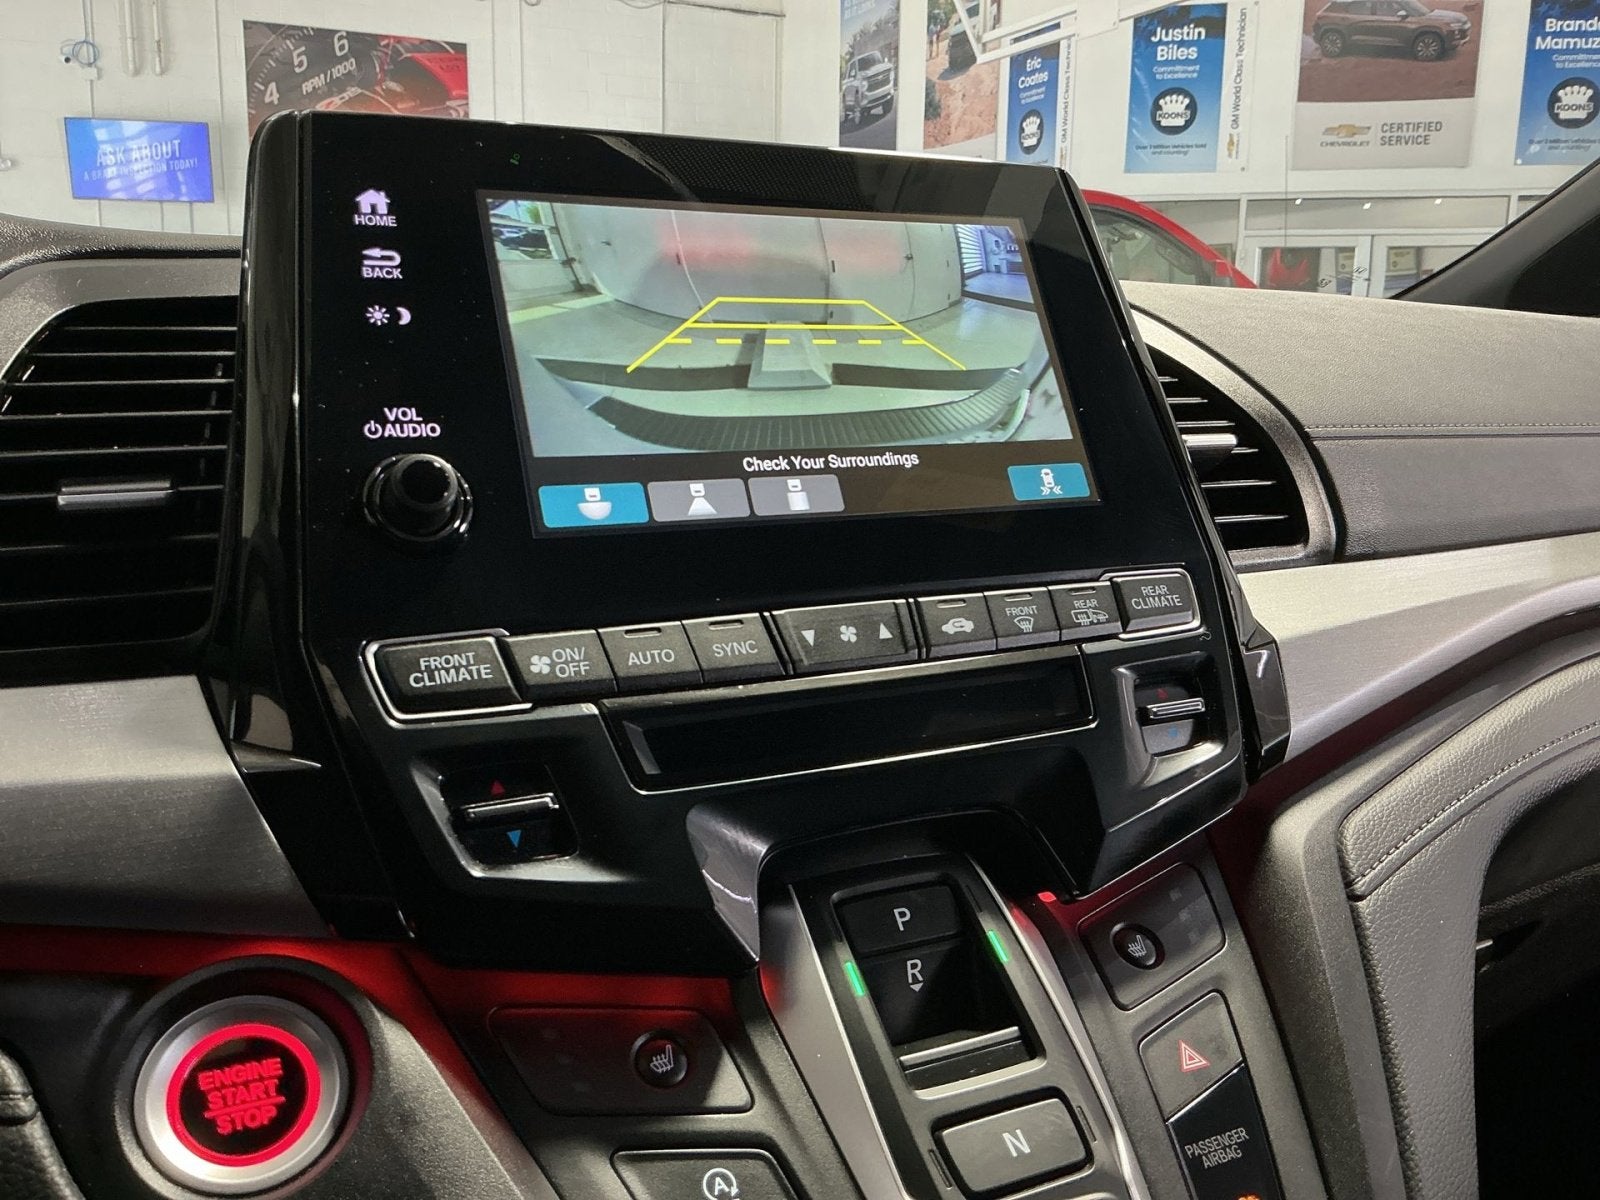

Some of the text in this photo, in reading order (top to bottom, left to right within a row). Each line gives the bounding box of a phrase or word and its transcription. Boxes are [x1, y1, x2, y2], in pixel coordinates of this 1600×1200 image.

[1150, 23, 1207, 42] Justin
[1235, 7, 1247, 58] Technician
[333, 31, 350, 57] 6
[1156, 44, 1199, 61] Biles
[292, 46, 309, 74] 5
[1026, 55, 1042, 72] Eric
[1018, 71, 1049, 89] Coates
[1234, 58, 1245, 85] Class
[263, 81, 281, 105] 4
[1232, 85, 1243, 113] World
[1157, 110, 1190, 120] KOONS
[1556, 103, 1592, 112] KOONS
[1230, 113, 1240, 130] GM
[1380, 120, 1443, 134] CERTIFIED
[1319, 140, 1371, 148] CHEVROLET
[1379, 134, 1431, 147] SERVICE
[97, 139, 181, 166] ASK ABOUT
[170, 157, 198, 171] TODAY!
[354, 213, 398, 227] HOME
[362, 266, 403, 279] BACK
[383, 407, 423, 421] VOL
[384, 422, 441, 437] AUDIO
[742, 451, 920, 472] Check Your Surroundings
[1140, 584, 1170, 596] REAR
[1004, 605, 1038, 617] FRONT
[1073, 598, 1099, 609] REAR
[1131, 594, 1184, 610] CLIMATE
[551, 646, 586, 663] ON/
[628, 648, 675, 666] AUTO
[712, 639, 758, 657] SYNC
[419, 651, 476, 671] FRONT
[555, 661, 590, 678] OFF
[408, 663, 494, 688] CLIMATE
[893, 907, 911, 932] P
[906, 958, 924, 984] R
[198, 1056, 284, 1091] ENGINE
[207, 1079, 279, 1110] START
[216, 1104, 278, 1136] STOP
[1002, 1128, 1032, 1158] N
[1184, 1127, 1250, 1159] PASSENGER
[1201, 1145, 1243, 1170] AIRBAG
